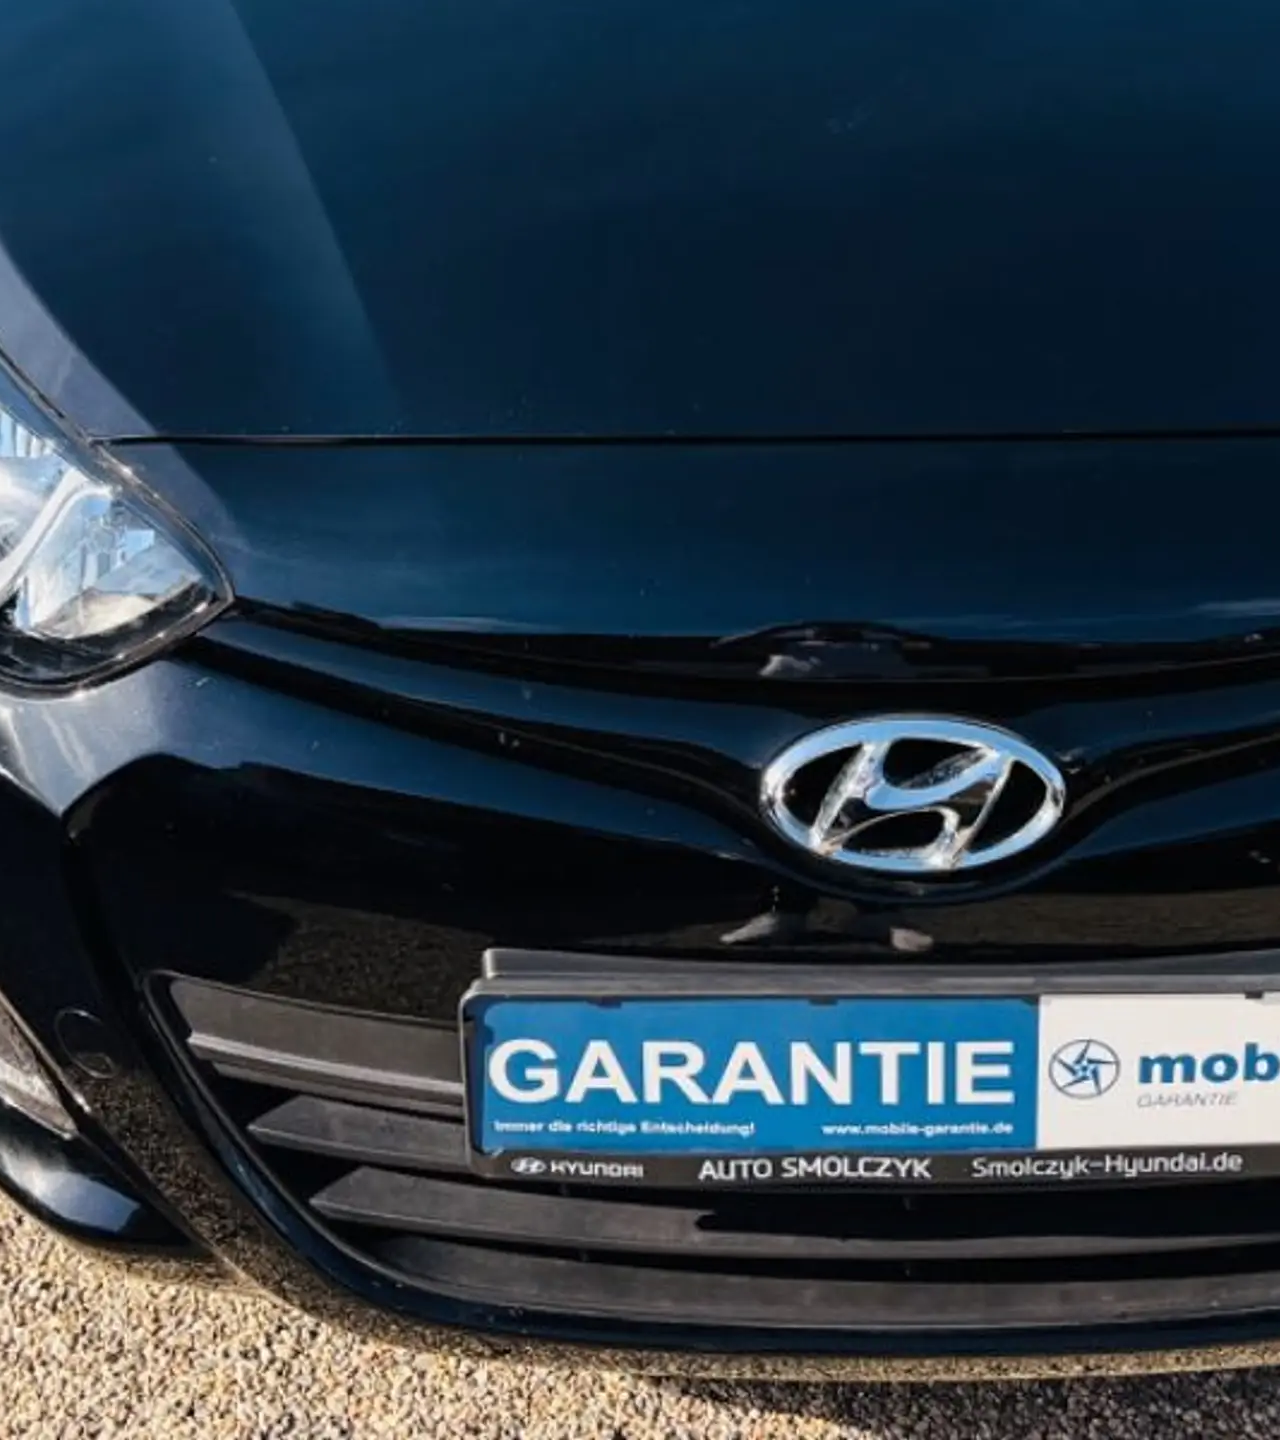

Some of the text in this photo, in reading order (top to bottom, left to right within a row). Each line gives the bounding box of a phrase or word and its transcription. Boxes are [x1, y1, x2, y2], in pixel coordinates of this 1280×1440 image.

[486, 1039, 1015, 1106] GARANTIE
[1136, 1092, 1238, 1109] GARANTIE
[493, 1119, 1015, 1139] Immer die richtige Entscheidung! www.mobile-garantie.de
[549, 1151, 1244, 1181] HYUNDAI AUTO SMOLCZYK Smolczyk-Hyundai.de
